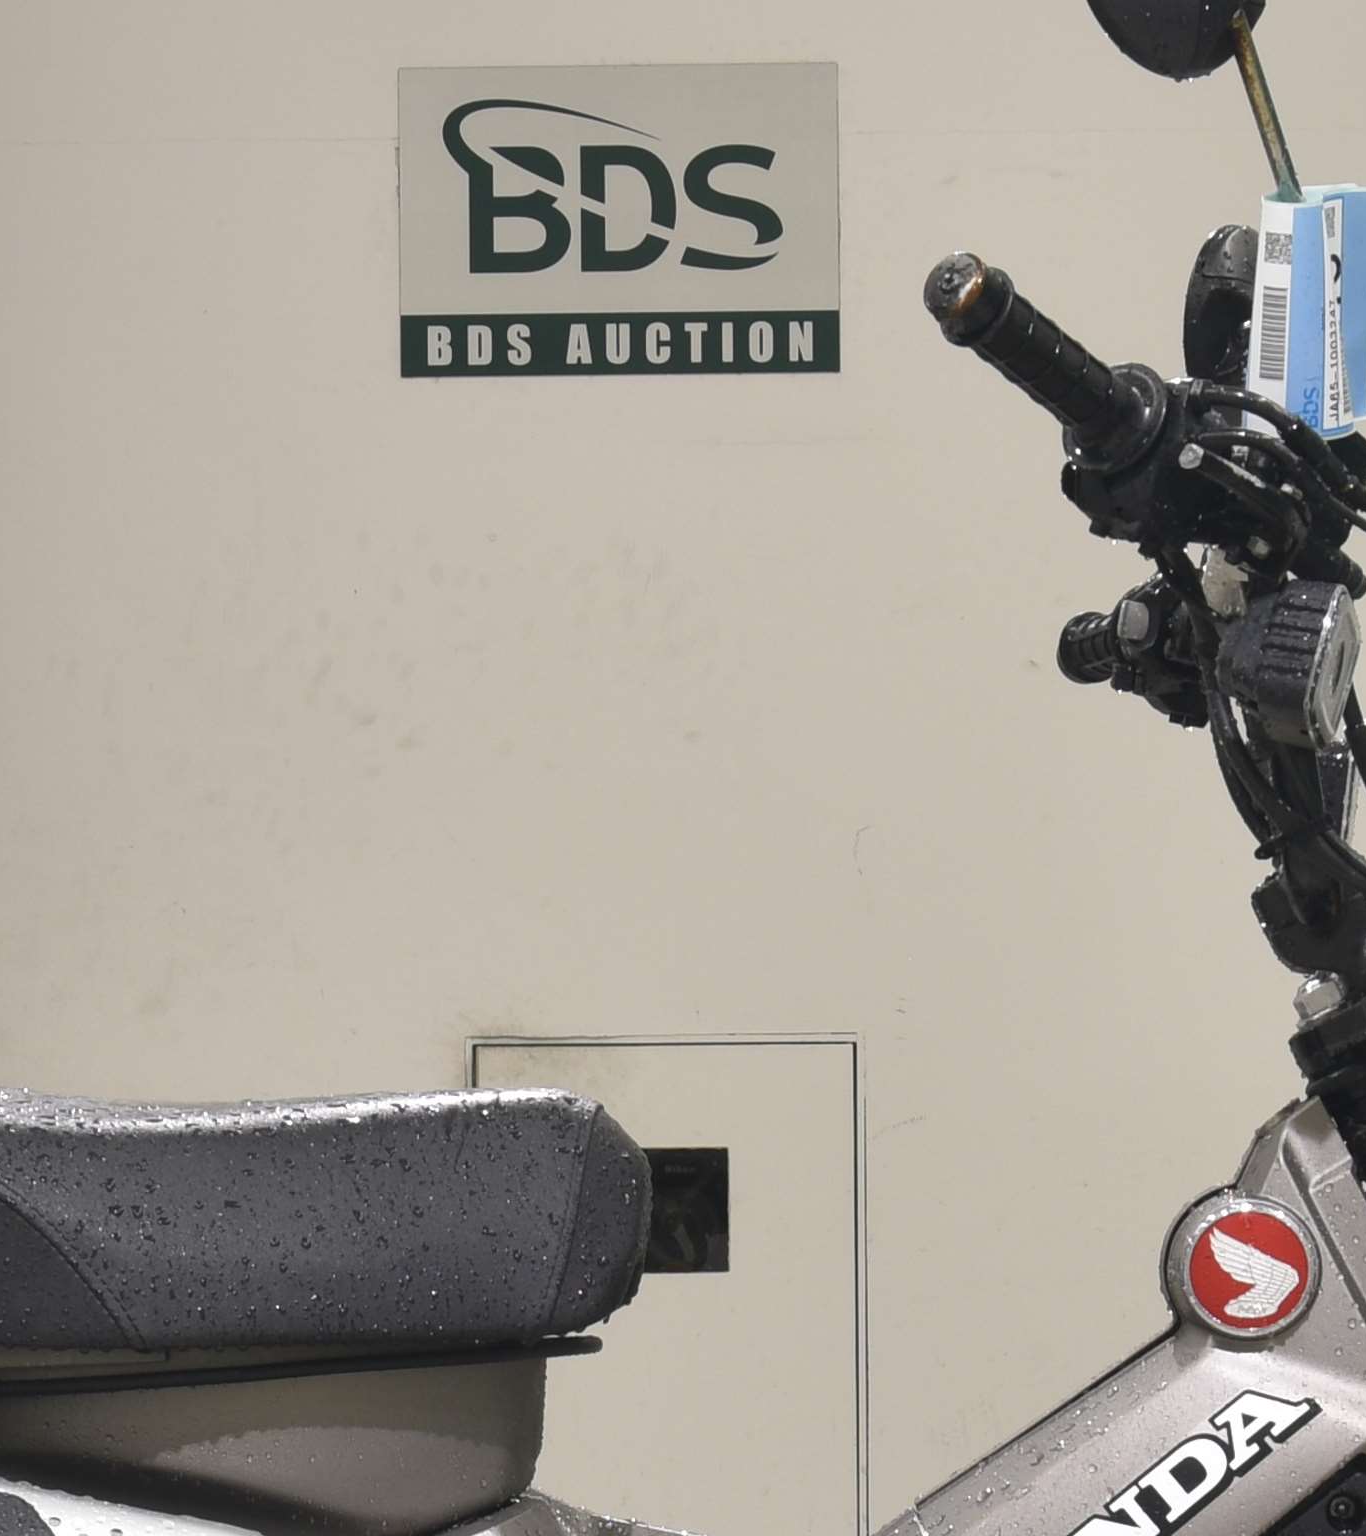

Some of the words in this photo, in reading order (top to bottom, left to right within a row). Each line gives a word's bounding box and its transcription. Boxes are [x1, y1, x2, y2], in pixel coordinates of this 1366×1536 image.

[442, 98, 784, 274] BDS
[426, 322, 533, 367] BDS
[565, 320, 815, 366] AUCTION
